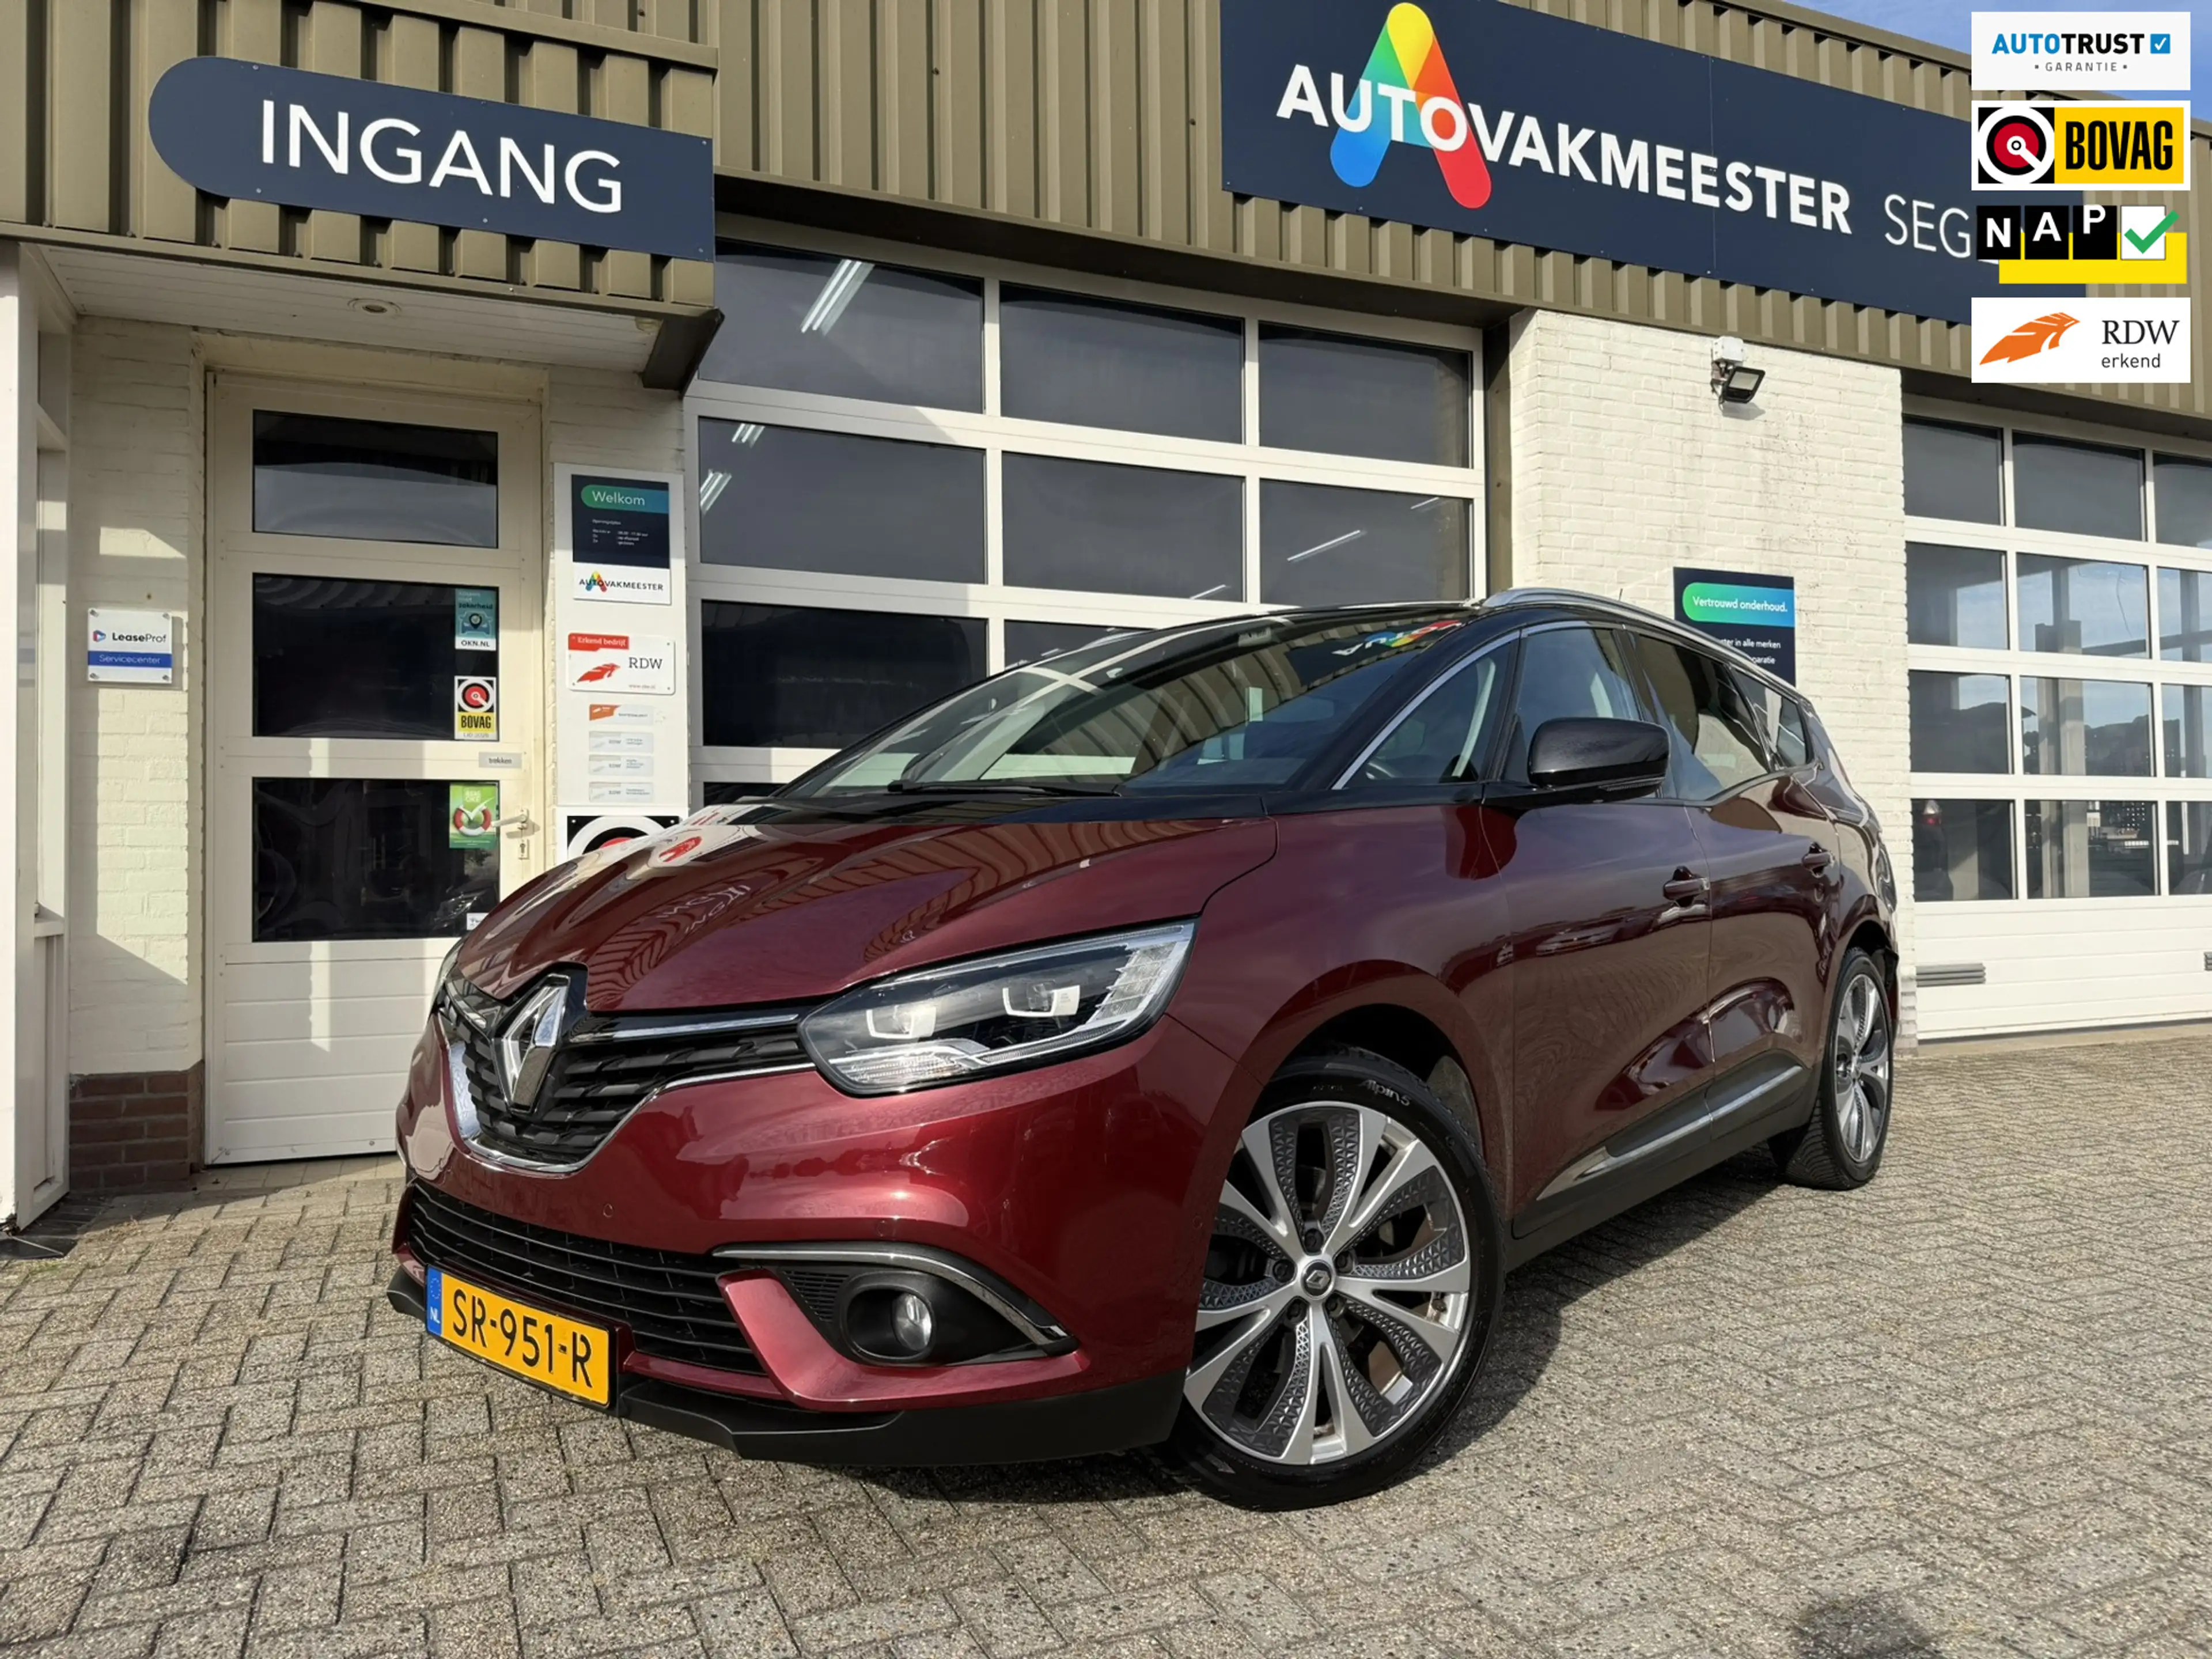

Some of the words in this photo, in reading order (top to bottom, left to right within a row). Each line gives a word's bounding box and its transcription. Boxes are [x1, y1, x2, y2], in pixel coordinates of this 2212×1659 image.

[262, 99, 622, 214] INGANG
[1275, 63, 1853, 235] AUTOVAKMEESTER
[1884, 194, 1971, 258] SEG
[592, 490, 646, 506] Welkom
[579, 578, 664, 592] AUTOVAKMEESTER
[1692, 596, 1738, 609] Vertrouwd
[1740, 599, 1788, 612] onderhoud.
[112, 632, 166, 643] LeaseProf
[461, 639, 490, 647] OKN.NL
[1734, 638, 1741, 646] in
[1743, 638, 1755, 647] alle
[1756, 639, 1781, 649] merken
[99, 654, 162, 665] Servicecenter
[628, 656, 662, 669] RDW
[461, 715, 491, 729] BOVAG
[430, 1306, 440, 1324] NL
[453, 1288, 593, 1388] SR-951-R
